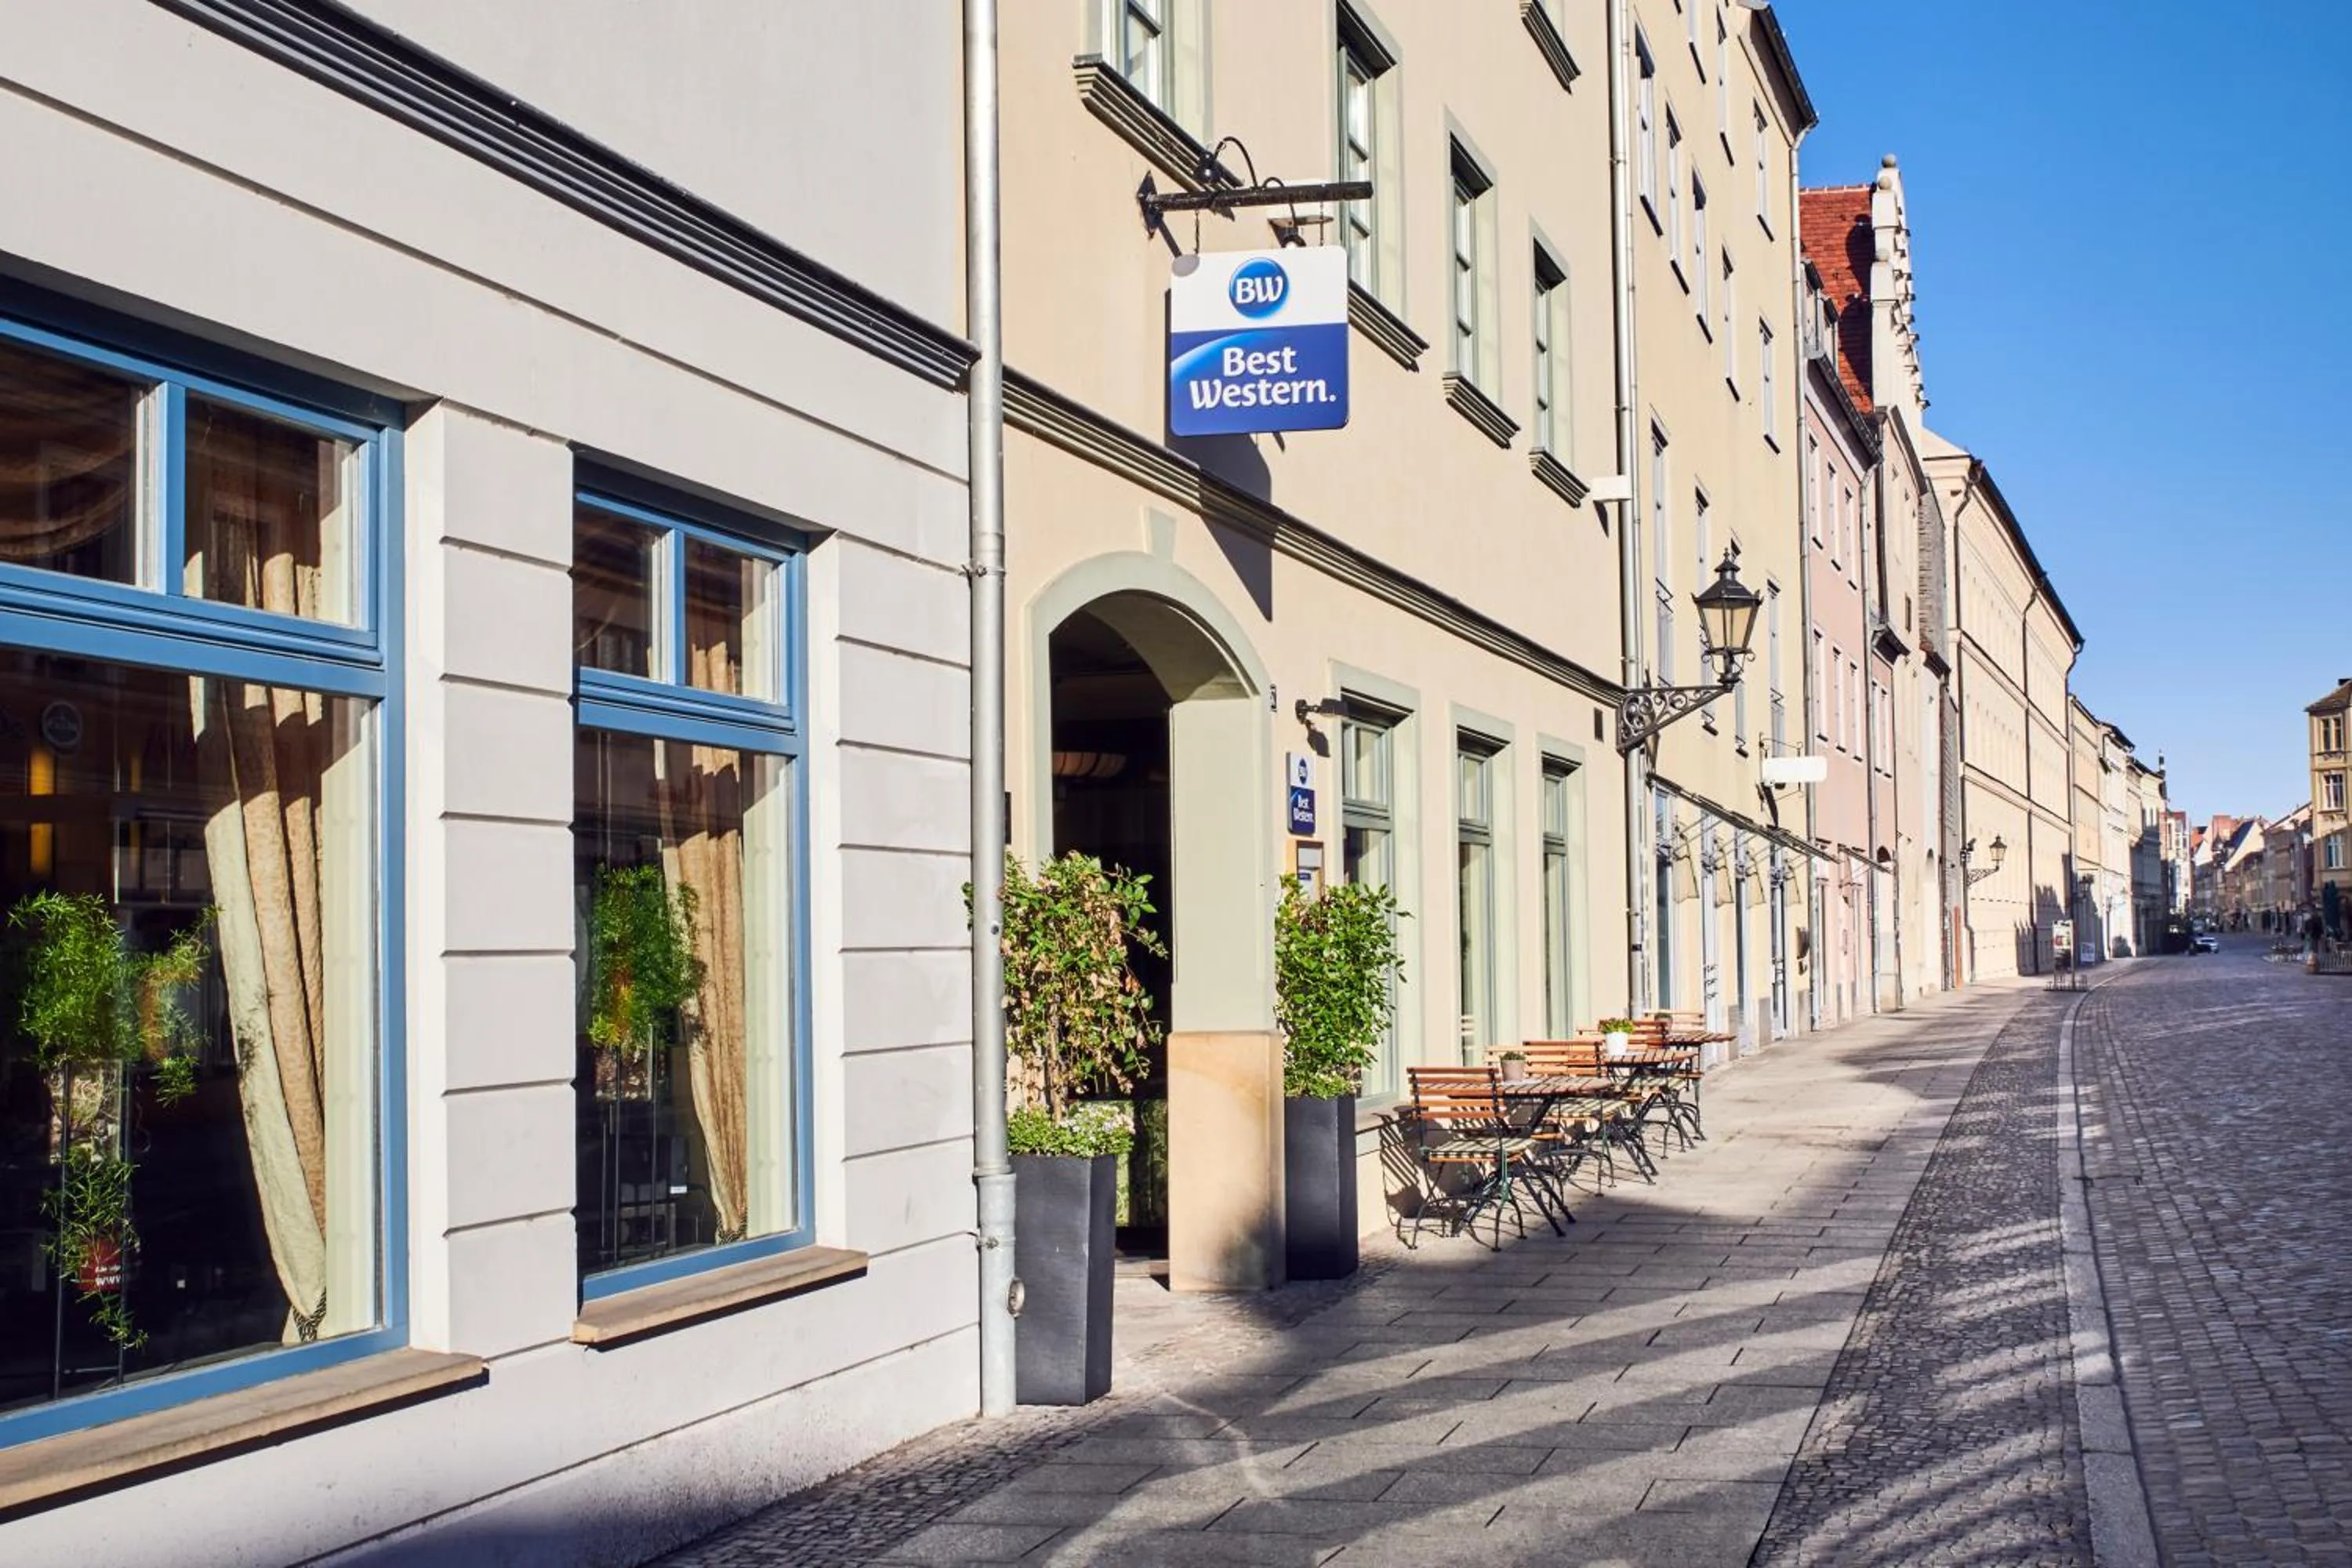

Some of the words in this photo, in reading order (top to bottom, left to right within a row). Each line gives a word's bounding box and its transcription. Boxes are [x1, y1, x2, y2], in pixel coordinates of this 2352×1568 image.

[1236, 275, 1283, 304] BW
[1222, 346, 1298, 377] Best
[1189, 378, 1337, 410] Western.
